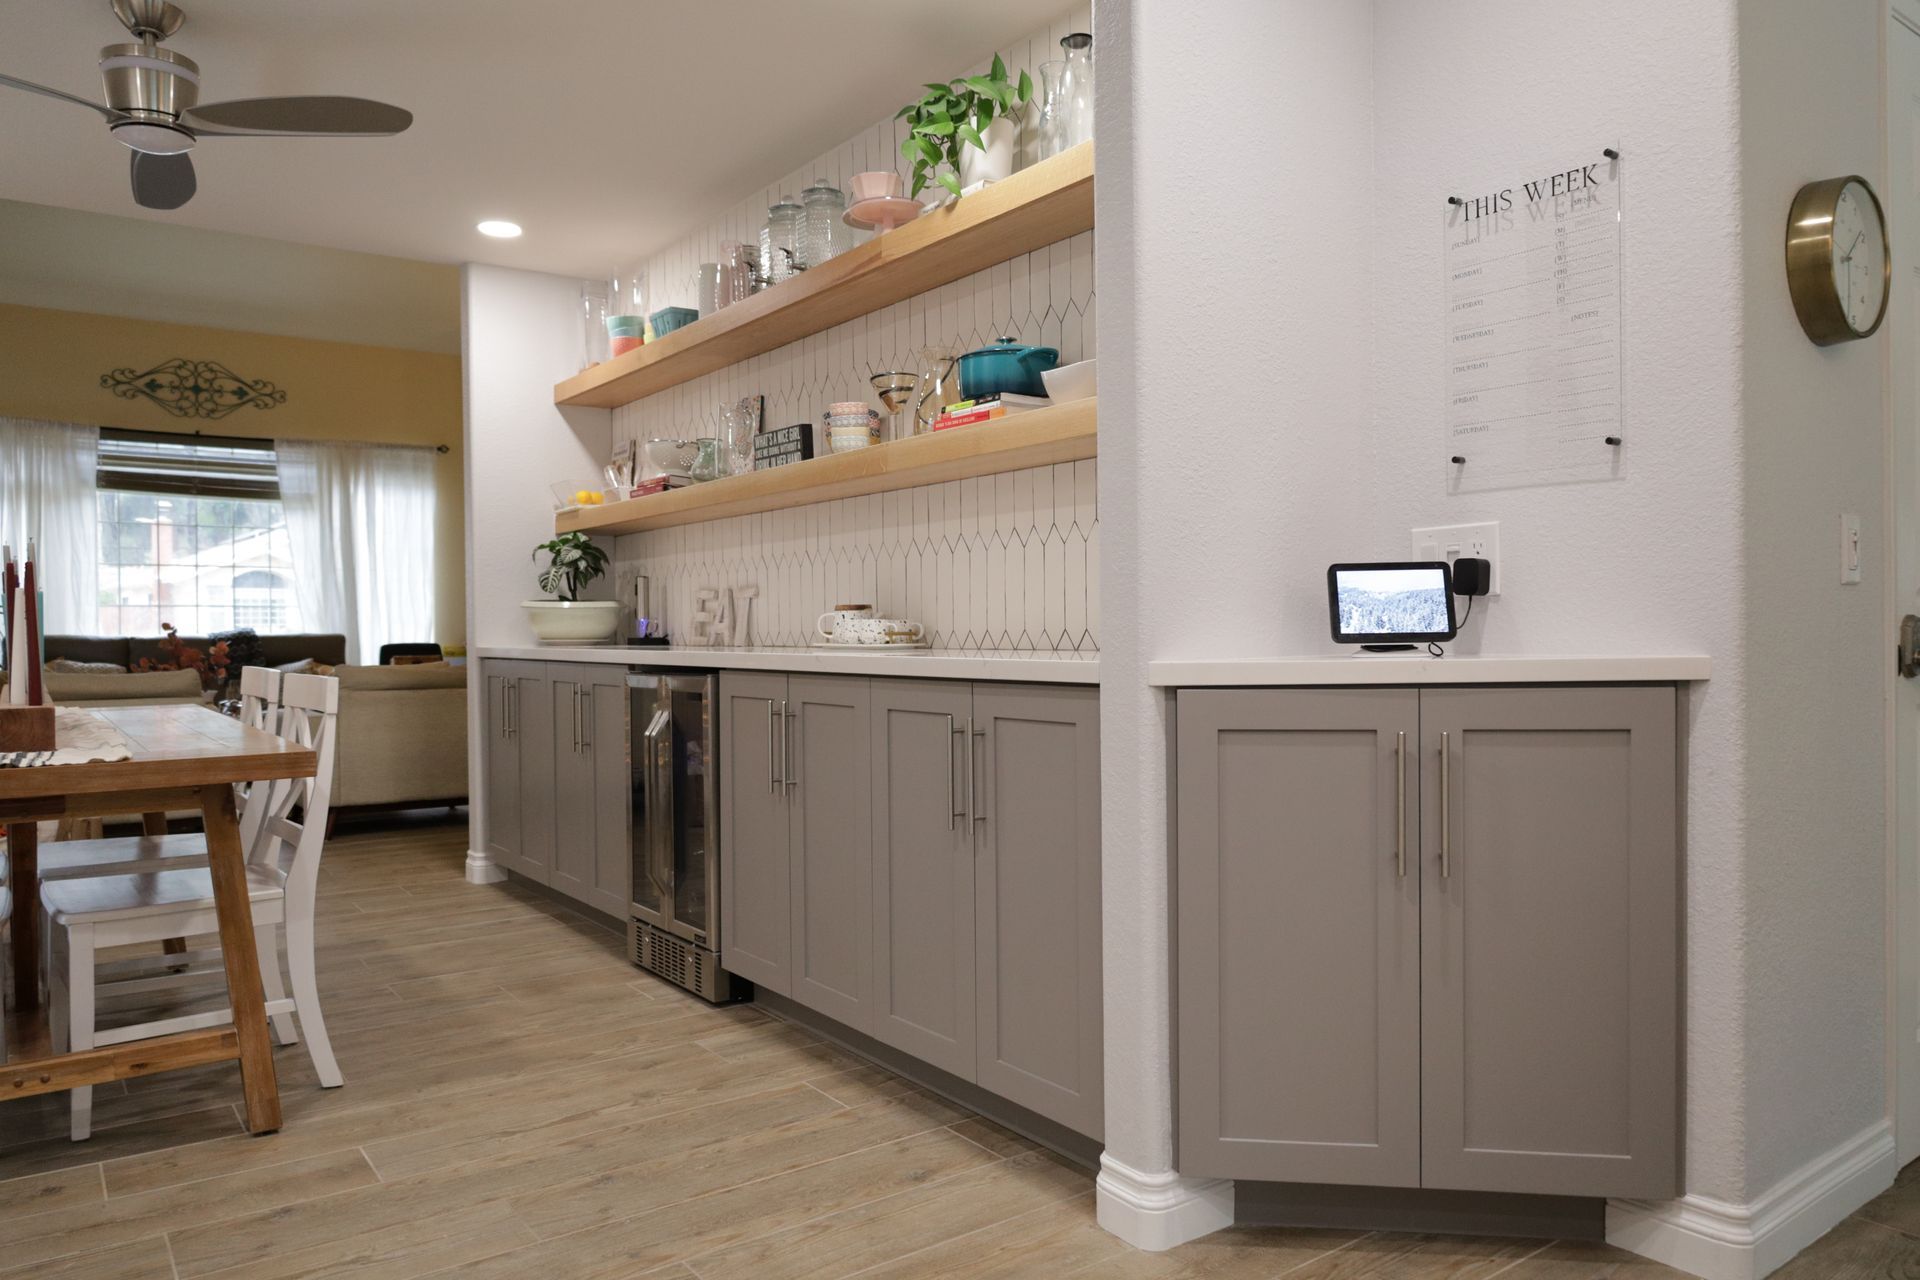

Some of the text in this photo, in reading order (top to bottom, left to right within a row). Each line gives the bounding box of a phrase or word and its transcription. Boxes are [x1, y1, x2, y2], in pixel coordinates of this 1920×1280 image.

[1463, 164, 1598, 222] THIS WEEK
[690, 584, 759, 648] EAT
